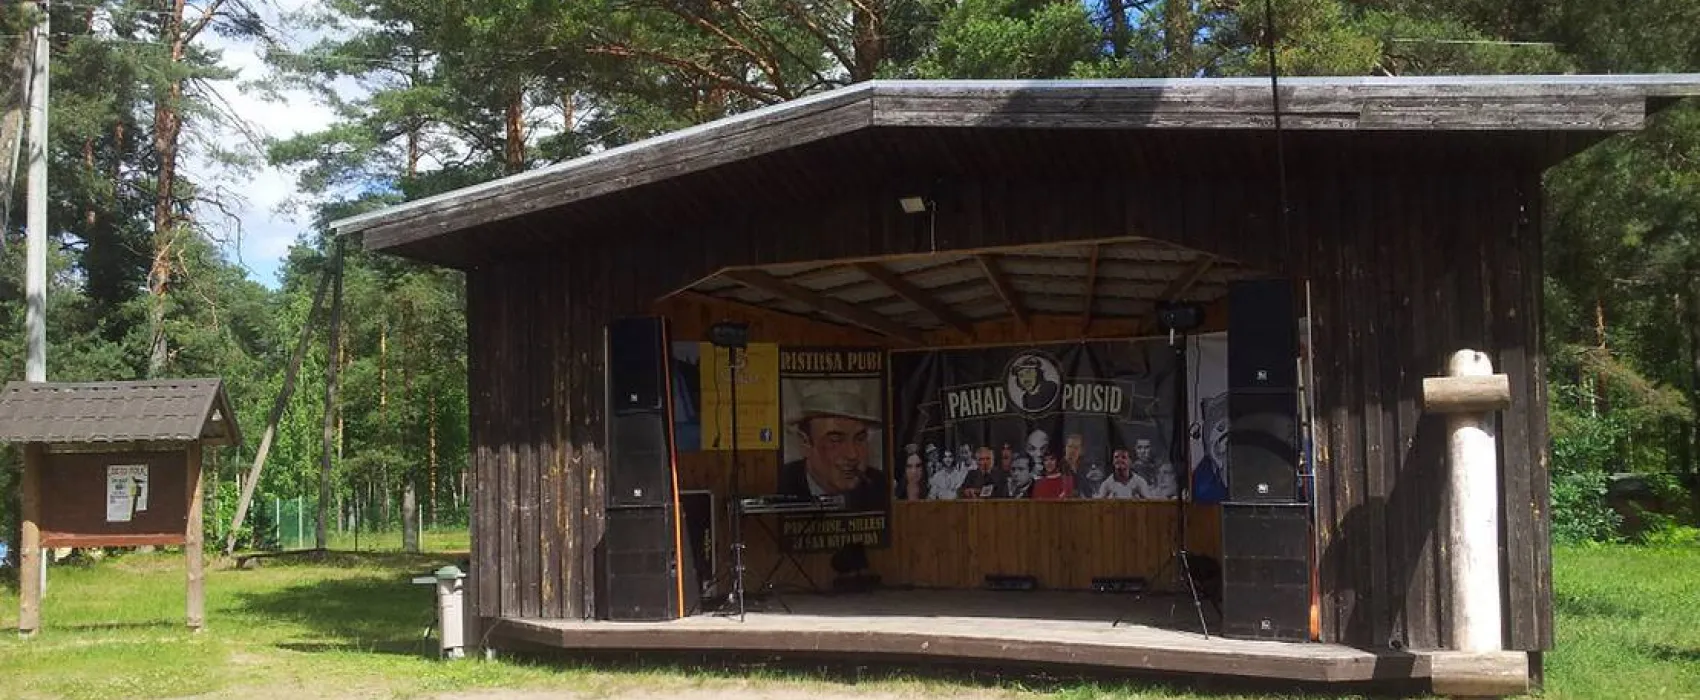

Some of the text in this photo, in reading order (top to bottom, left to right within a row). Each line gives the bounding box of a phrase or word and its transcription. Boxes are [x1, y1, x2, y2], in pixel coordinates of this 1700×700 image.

[847, 351, 883, 371] PUBI
[947, 383, 1122, 419] PAHAD POISID
